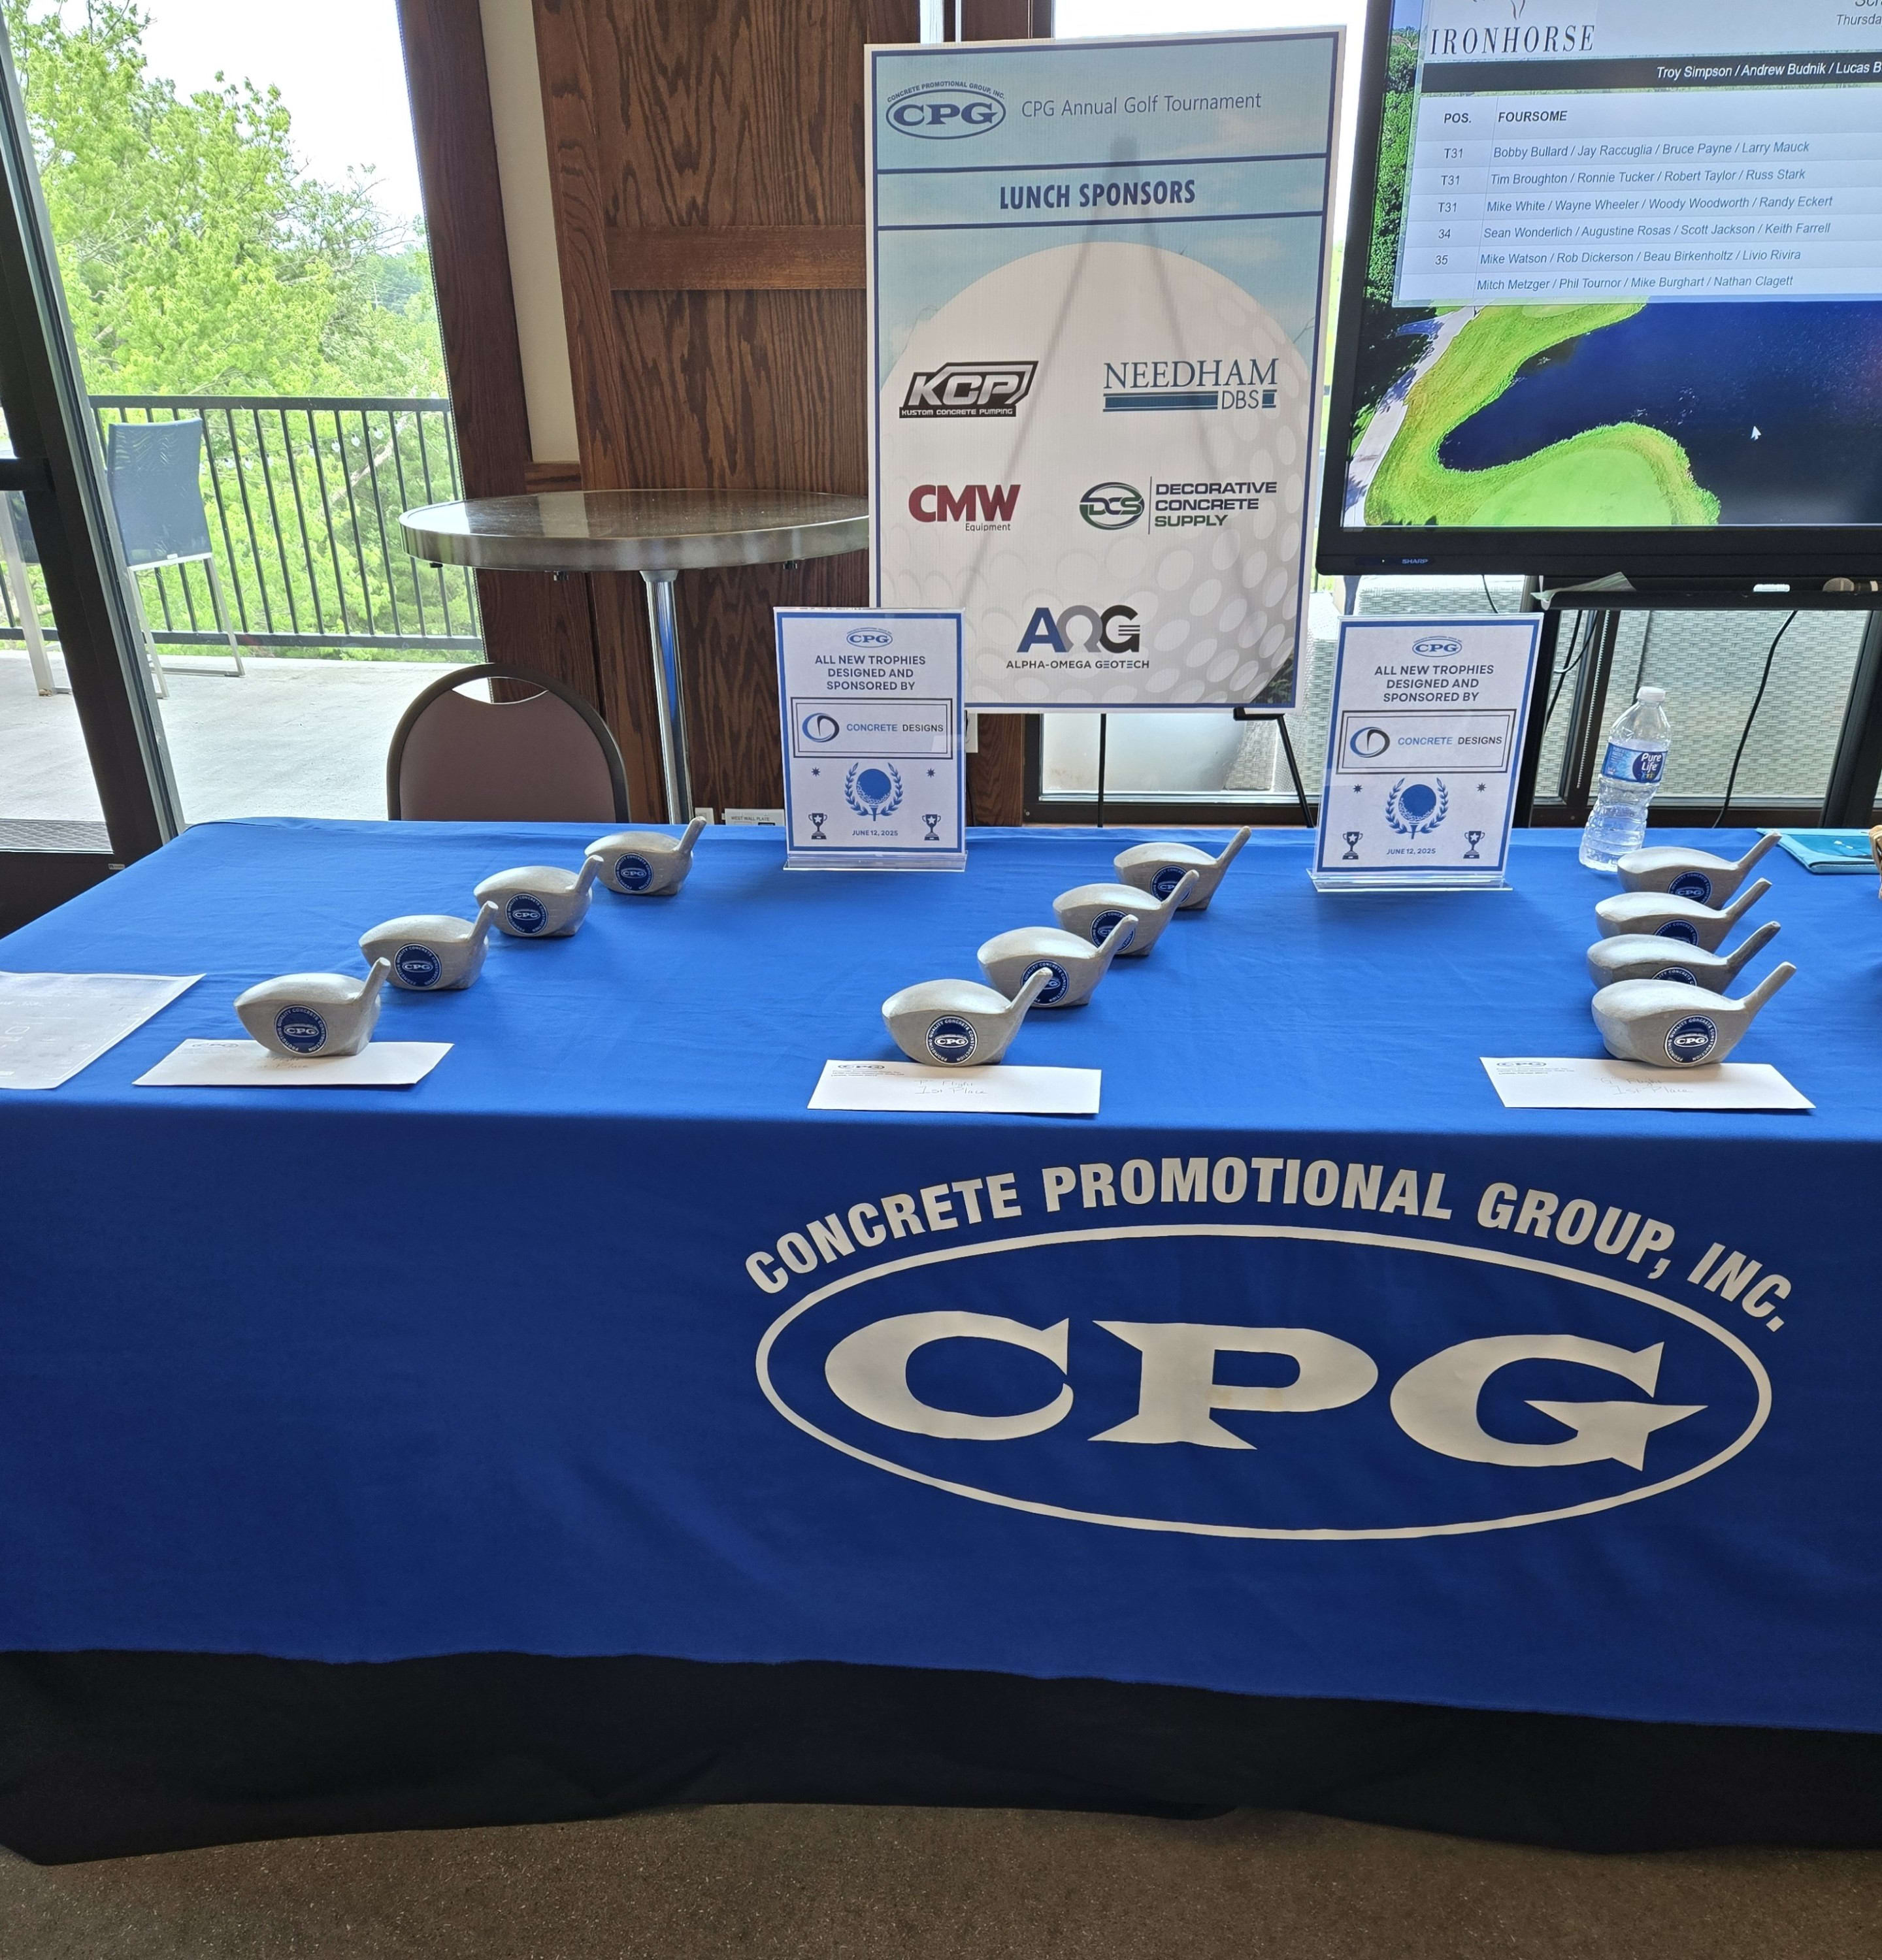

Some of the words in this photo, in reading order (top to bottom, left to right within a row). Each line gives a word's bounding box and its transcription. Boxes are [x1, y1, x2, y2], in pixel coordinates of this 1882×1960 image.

[1836, 14, 1882, 27] Thursda
[1430, 25, 1595, 56] IRONHORSE
[1657, 67, 1681, 80] Troy
[1684, 66, 1732, 80] Simpson
[1741, 64, 1785, 76] Andrew
[1787, 63, 1826, 75] Budnik
[1836, 62, 1870, 74] Lucas
[887, 85, 920, 103] CONCRETE
[921, 81, 967, 90] PROMOTIONAL
[993, 89, 1005, 99] INC.
[1021, 100, 1055, 118] CPG
[1061, 97, 1117, 116] Annual
[1124, 95, 1159, 113] Golf
[1165, 92, 1262, 112] Tournament
[893, 102, 998, 126] CPG
[1444, 113, 1472, 123] POS.
[1498, 110, 1568, 123] FOURSOME
[1444, 148, 1463, 159] T31
[1493, 147, 1528, 160] Bobby
[1530, 146, 1568, 157] Bullard
[1577, 146, 1596, 158] Jay
[1600, 144, 1652, 157] Raccuglia
[1662, 144, 1694, 155] Bruce
[1698, 143, 1732, 156] Payne
[1742, 142, 1770, 155] Larry
[1773, 142, 1809, 152] Mauck
[1441, 175, 1460, 186] T31
[1491, 174, 1510, 184] Tim
[1513, 174, 1568, 186] Broughton
[1577, 172, 1615, 183] Ronnie
[1619, 172, 1655, 182] Tucker
[1664, 171, 1701, 182] Robert
[1704, 171, 1736, 184] Taylor
[1746, 170, 1774, 180] Russ
[1777, 169, 1806, 180] Stark
[1000, 184, 1070, 210] LUNCH
[1079, 180, 1196, 207] SPONSORS
[1438, 203, 1457, 212] T31
[1487, 201, 1512, 212] Mike
[1515, 201, 1545, 211] White
[1555, 201, 1591, 214] Wayne
[1594, 199, 1640, 210] Wheeler
[1649, 199, 1686, 211] Woody
[1689, 198, 1749, 209] Woodworth
[1759, 197, 1795, 210] Randy
[1798, 196, 1833, 207] Eckert
[1438, 229, 1451, 239] 34
[1484, 228, 1511, 238] Sean
[1515, 227, 1572, 238] Wonderlich
[1581, 226, 1634, 239] Augustine
[1637, 225, 1671, 236] Rosas
[1681, 225, 1708, 235] Scott
[1711, 224, 1755, 235] Jackson
[1765, 223, 1792, 234] Keith
[1796, 223, 1831, 233] Farrell
[1435, 255, 1448, 265] 35
[1480, 254, 1505, 265] Mike
[1508, 253, 1547, 264] Watson
[1557, 253, 1578, 263] Rob
[1581, 252, 1634, 263] Dickerson
[1643, 252, 1670, 262] Beau
[1674, 251, 1733, 261] Birkenholtz
[1743, 250, 1767, 261] Livio
[1770, 250, 1801, 260] Rivira
[1477, 280, 1504, 291] Mitch
[1508, 279, 1550, 291] Metzger
[1559, 278, 1579, 289] Phil
[1582, 278, 1622, 288] Tournor
[1631, 278, 1656, 287] Mike
[1659, 276, 1704, 289] Burghart
[1713, 276, 1751, 287] Nathan
[1755, 276, 1793, 288] Clagett
[1104, 358, 1279, 389] NEEDHAM
[908, 368, 1026, 406] KCP
[1222, 390, 1259, 410] DBS
[1155, 482, 1278, 495] DECORATIVE
[908, 484, 1021, 523] CMW
[1155, 498, 1259, 512] CONCRETE
[965, 522, 1010, 532] Equipment
[1154, 515, 1229, 527] SUPPLY
[849, 634, 889, 644] CPG
[1415, 644, 1459, 653] CPG
[815, 655, 836, 665] ALL
[838, 655, 865, 665] NEW
[868, 655, 926, 665] TROPHIES
[1006, 660, 1092, 669] ALPHA-OMEGA
[1095, 660, 1150, 669] GEOTECH
[828, 668, 886, 678] DESIGNED
[889, 668, 914, 678] AND
[1375, 666, 1396, 676] ALL
[1400, 666, 1429, 675] NEW
[1432, 665, 1494, 675] TROPHIES
[827, 681, 898, 691] SPONSORED
[901, 681, 916, 691] BY
[1387, 679, 1449, 689] DESIGNED
[1452, 678, 1479, 688] AND
[1383, 693, 1459, 702] SPONSORED
[1462, 692, 1479, 702] BY
[846, 723, 897, 732] CONCRETE
[902, 723, 944, 732] DESIGNS
[1398, 737, 1453, 745] CONCRETE
[1457, 736, 1502, 745] DESIGNS
[1641, 753, 1662, 762] Pure
[1641, 762, 1657, 773] Life
[292, 1008, 319, 1021] CONCRETE
[929, 1021, 944, 1038] QUALITY
[944, 1019, 970, 1030] CONCRETE
[1670, 1021, 1687, 1038] QUALITY
[1688, 1018, 1713, 1028] CONCRETE
[929, 1039, 948, 1062] PROMOTING
[956, 1030, 974, 1062] CONSTRUCTION
[745, 1173, 1022, 1294] CONCRETE
[1042, 1156, 1453, 1220] PROMOTIONAL
[1477, 1182, 1676, 1280] GROUP,
[1687, 1241, 1792, 1333] INC.
[825, 1310, 1709, 1472] CPG
